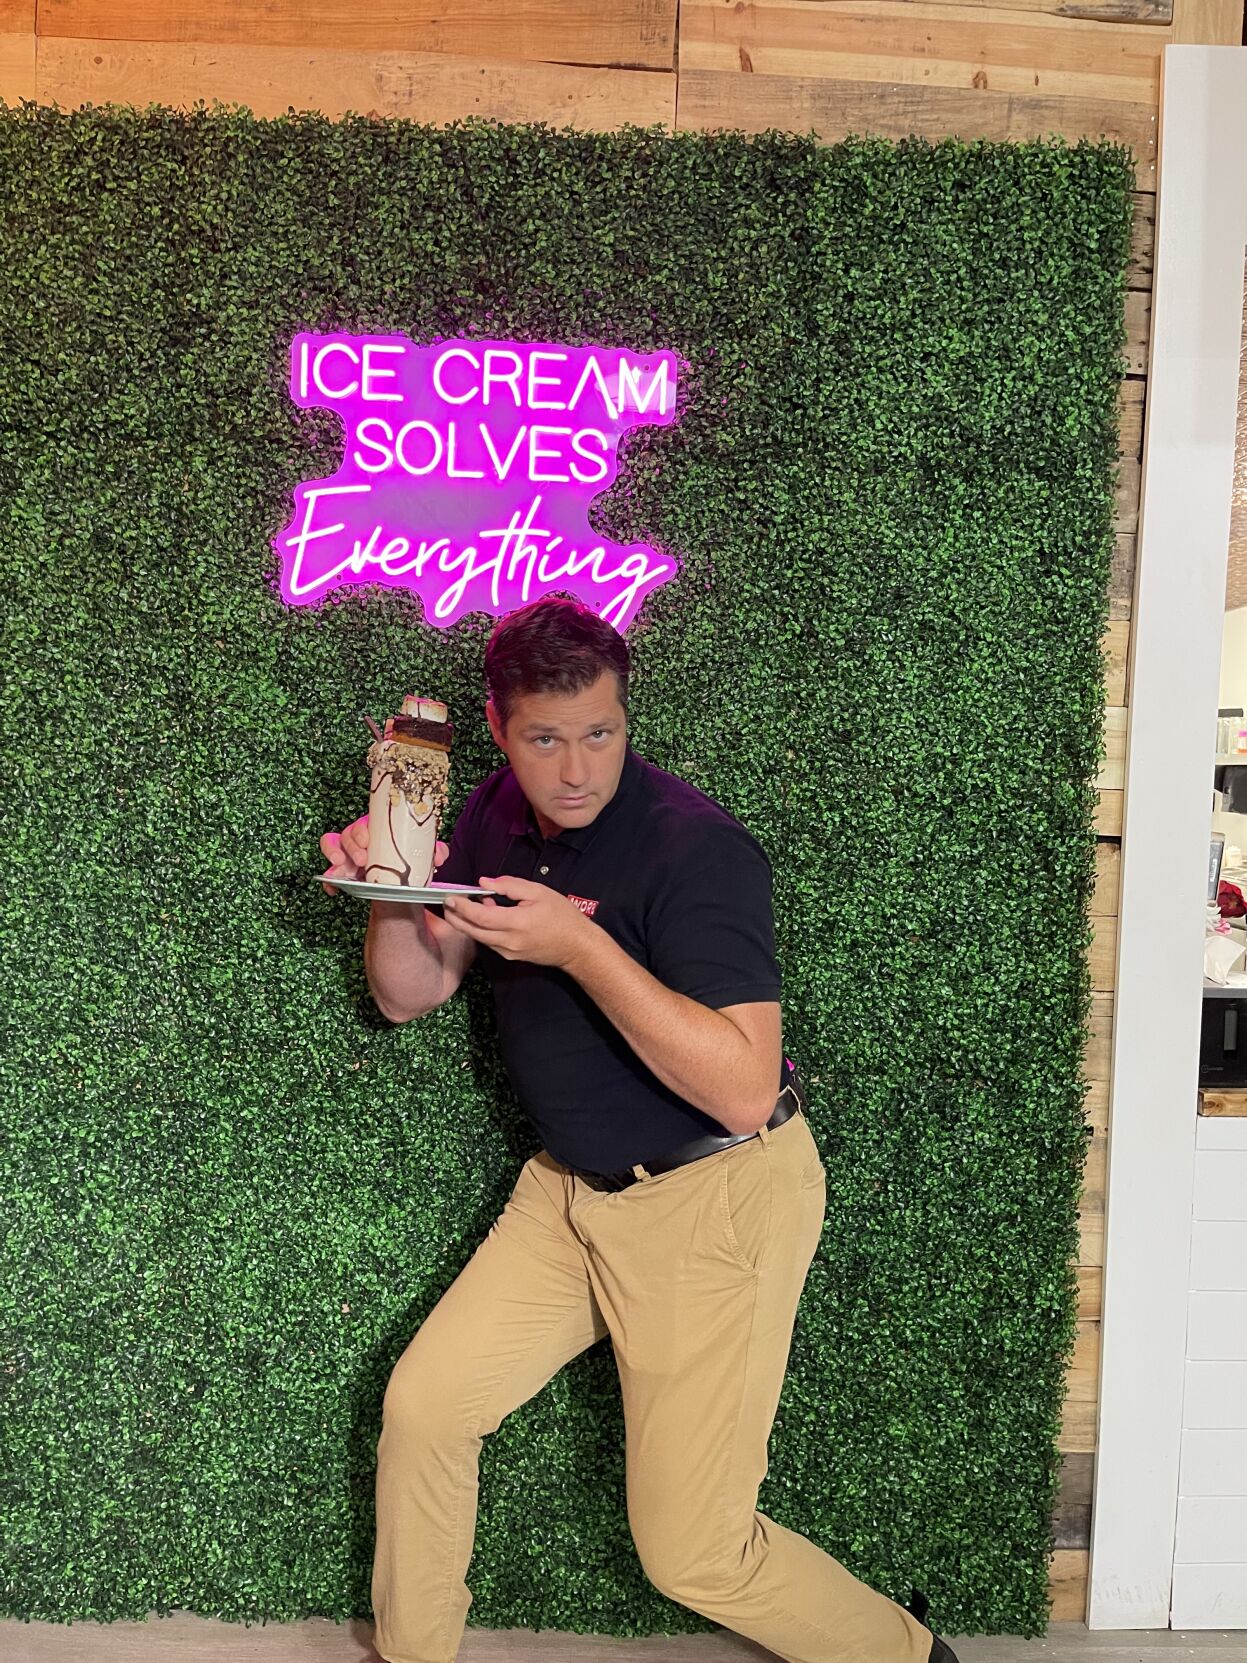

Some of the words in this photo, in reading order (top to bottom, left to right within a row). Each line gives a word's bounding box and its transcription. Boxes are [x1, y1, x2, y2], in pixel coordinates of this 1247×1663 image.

[300, 342, 405, 402] ICE
[433, 348, 669, 419] CREAM
[353, 418, 609, 483] SOLVES
[286, 485, 669, 628] Everything
